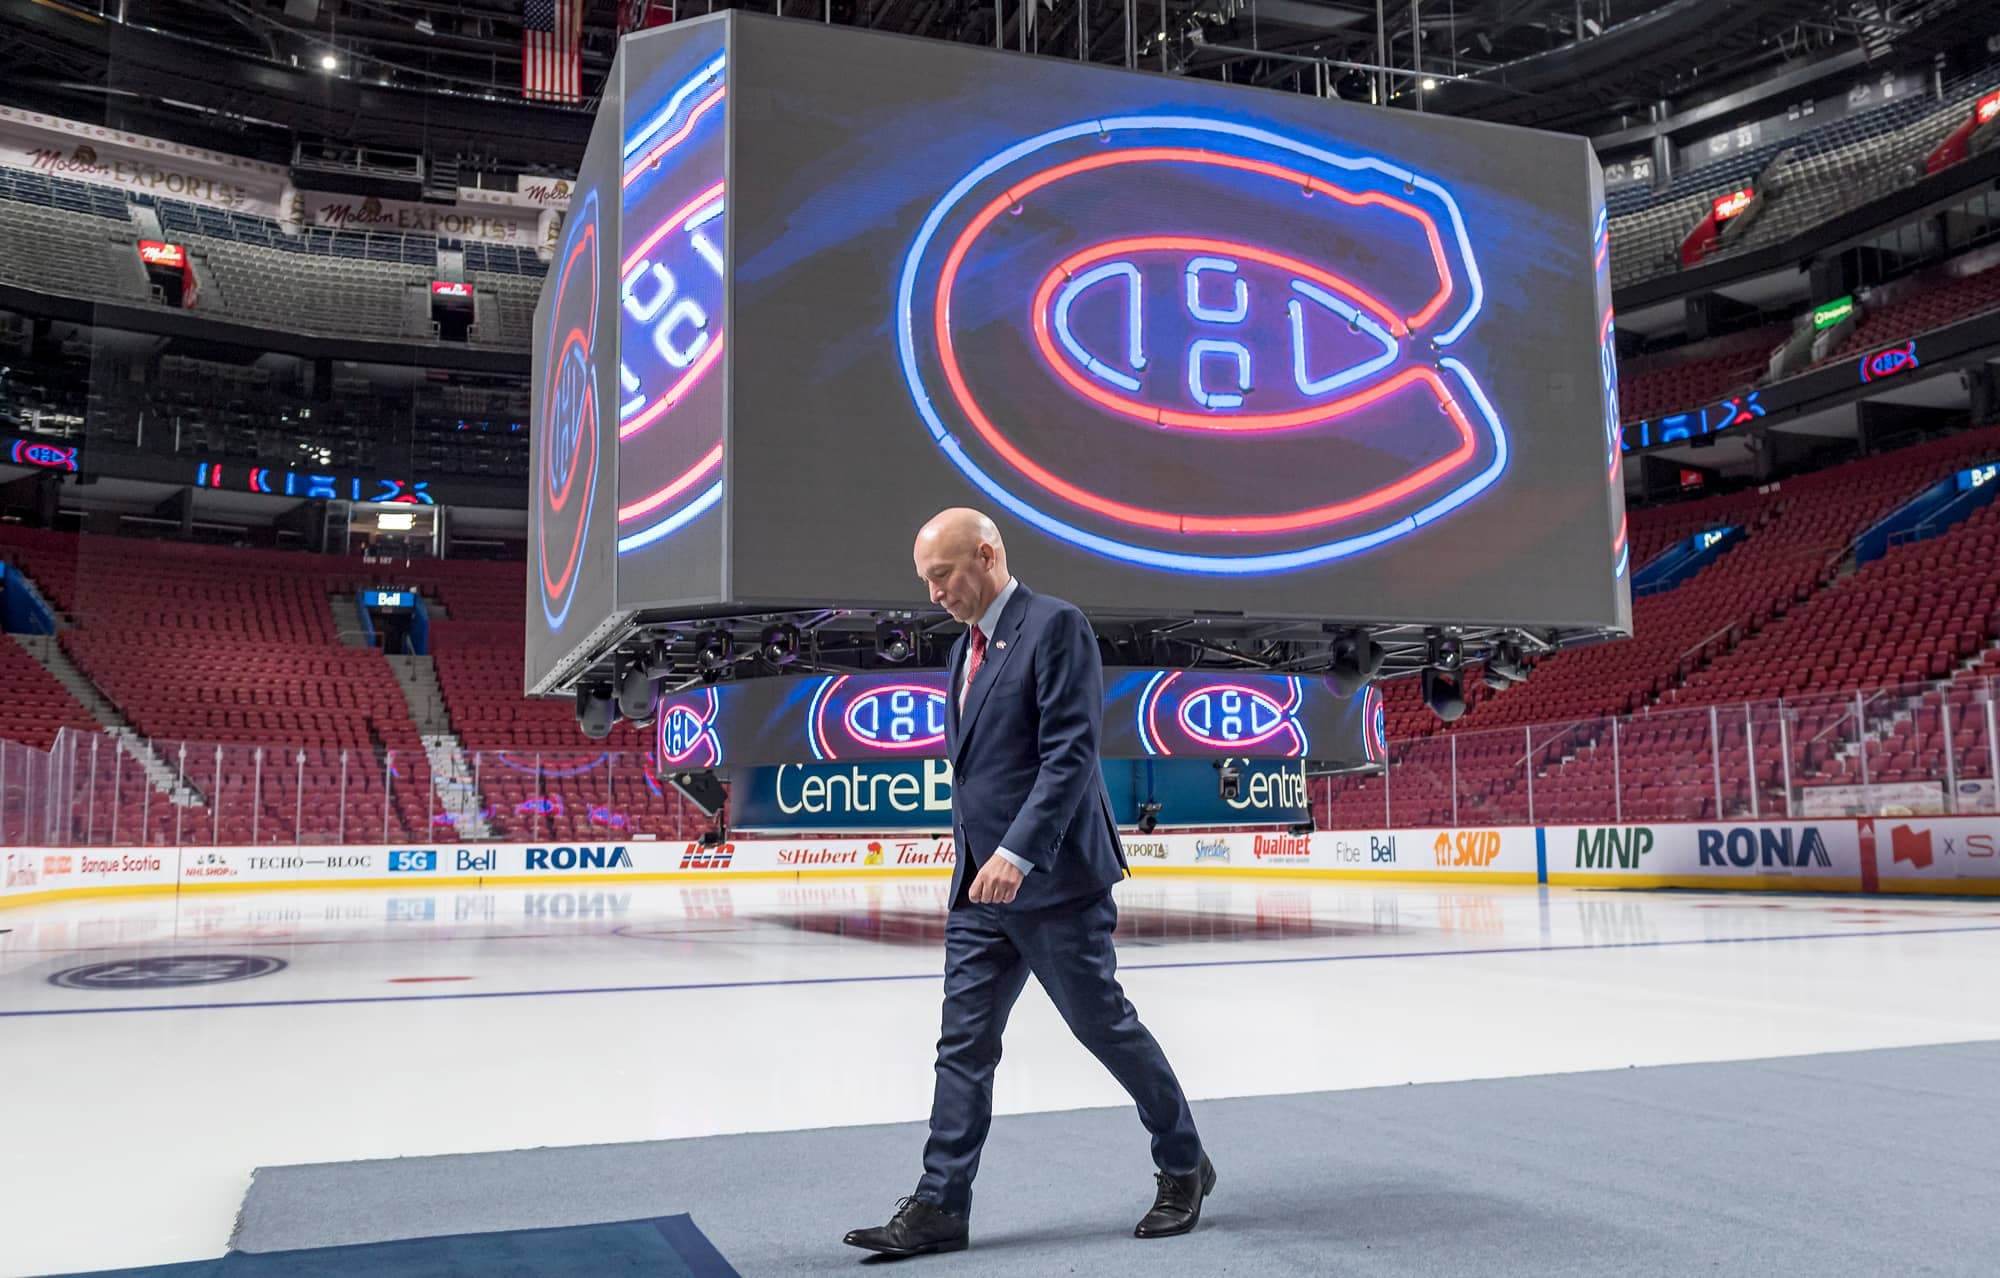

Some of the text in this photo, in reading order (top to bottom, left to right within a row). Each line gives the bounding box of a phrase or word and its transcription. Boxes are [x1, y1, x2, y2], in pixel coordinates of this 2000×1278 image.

[26, 149, 109, 176] Molson
[320, 201, 394, 228] Molson
[378, 592, 401, 606] Bell
[525, 847, 633, 870] RONA
[895, 843, 929, 865] Tim
[1253, 834, 1311, 859] Qualinet
[1336, 836, 1396, 863] Fibe Bell
[1453, 831, 1501, 866] SKIP
[1576, 827, 1654, 868] MNP
[1698, 827, 1832, 867] RONA
[81, 856, 119, 878] Banque
[122, 854, 160, 872] Scotia
[397, 852, 428, 870] 5G
[456, 849, 496, 871] Bell
